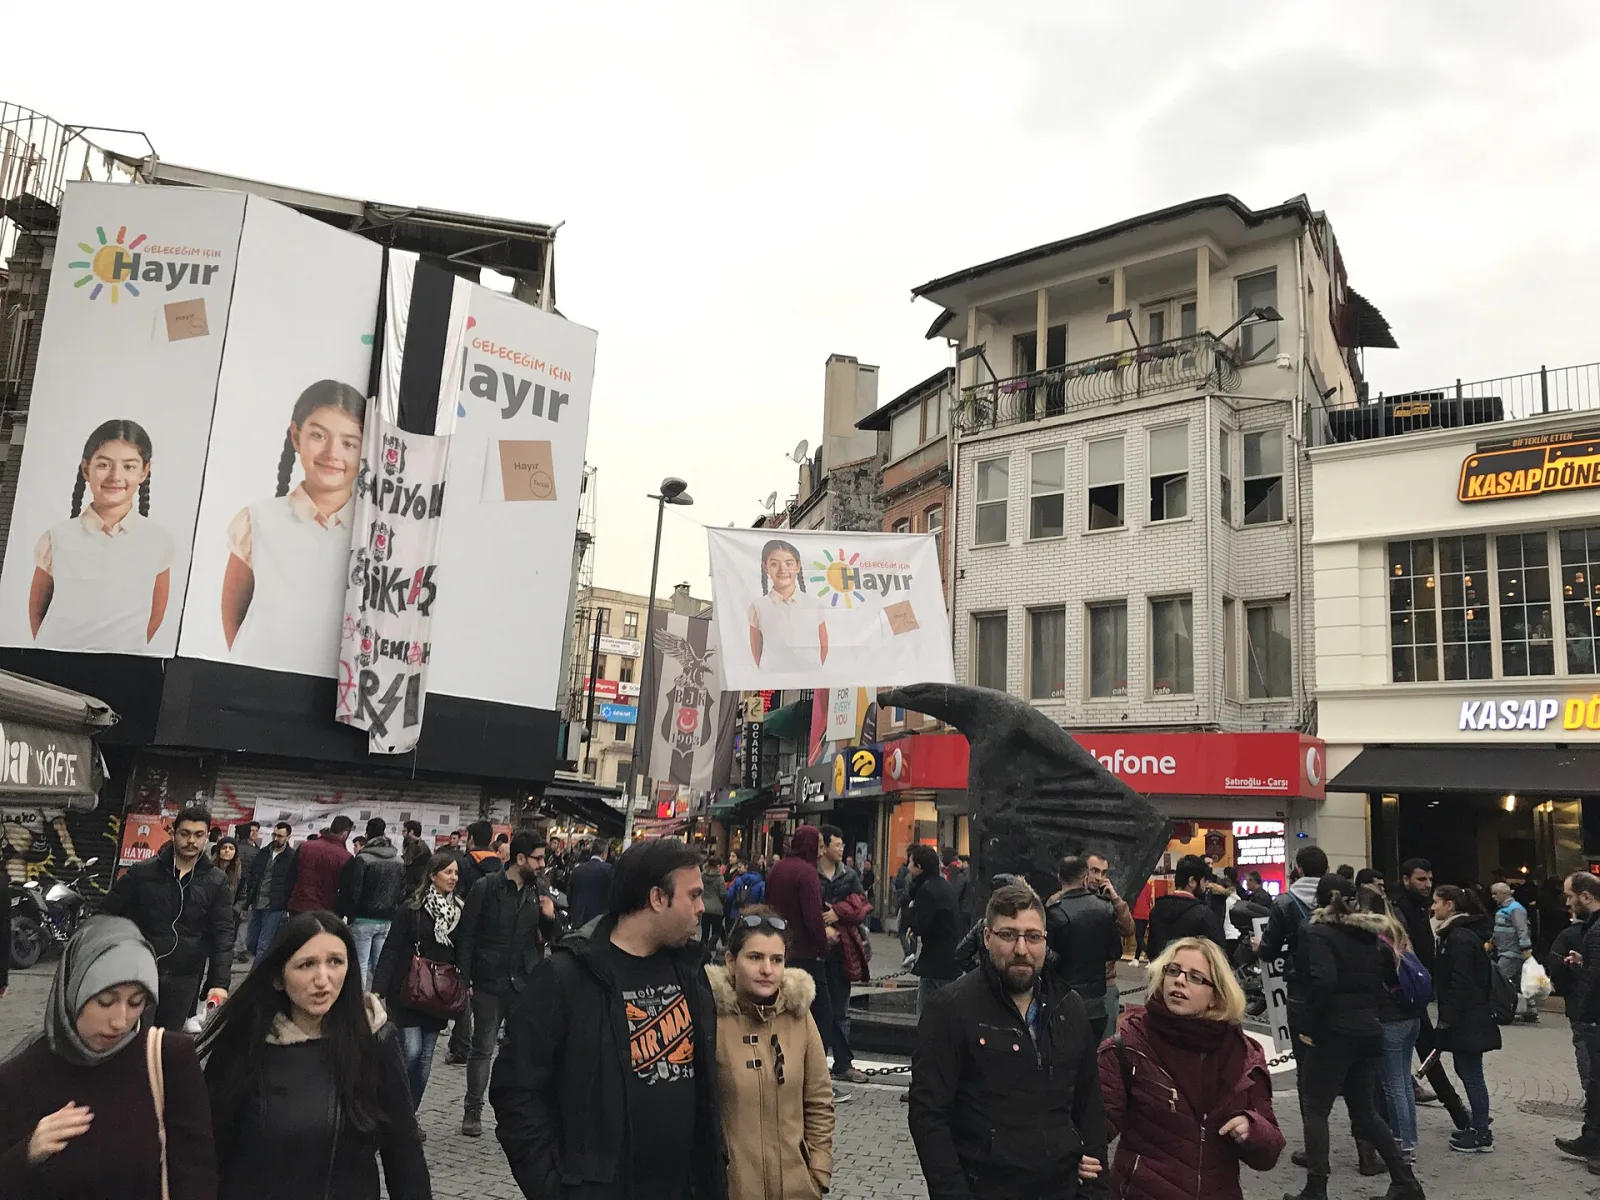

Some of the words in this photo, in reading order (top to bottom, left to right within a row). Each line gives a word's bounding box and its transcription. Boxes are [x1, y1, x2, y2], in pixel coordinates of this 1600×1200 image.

[112, 251, 219, 292] Hayır
[472, 337, 545, 373] GELECEĞİM
[549, 364, 572, 382] İÇİN
[1550, 432, 1573, 443] ETTEN
[513, 461, 540, 472] Hayır
[1467, 468, 1542, 498] KASAP
[841, 567, 913, 597] Hayır
[675, 690, 706, 706] BJK
[837, 688, 849, 700] FOR
[1153, 687, 1170, 695] cafe
[1459, 699, 1558, 730] KASAP
[671, 733, 701, 746] 1903
[36, 743, 78, 786] KÖFTE
[631, 1029, 660, 1067] AIR
